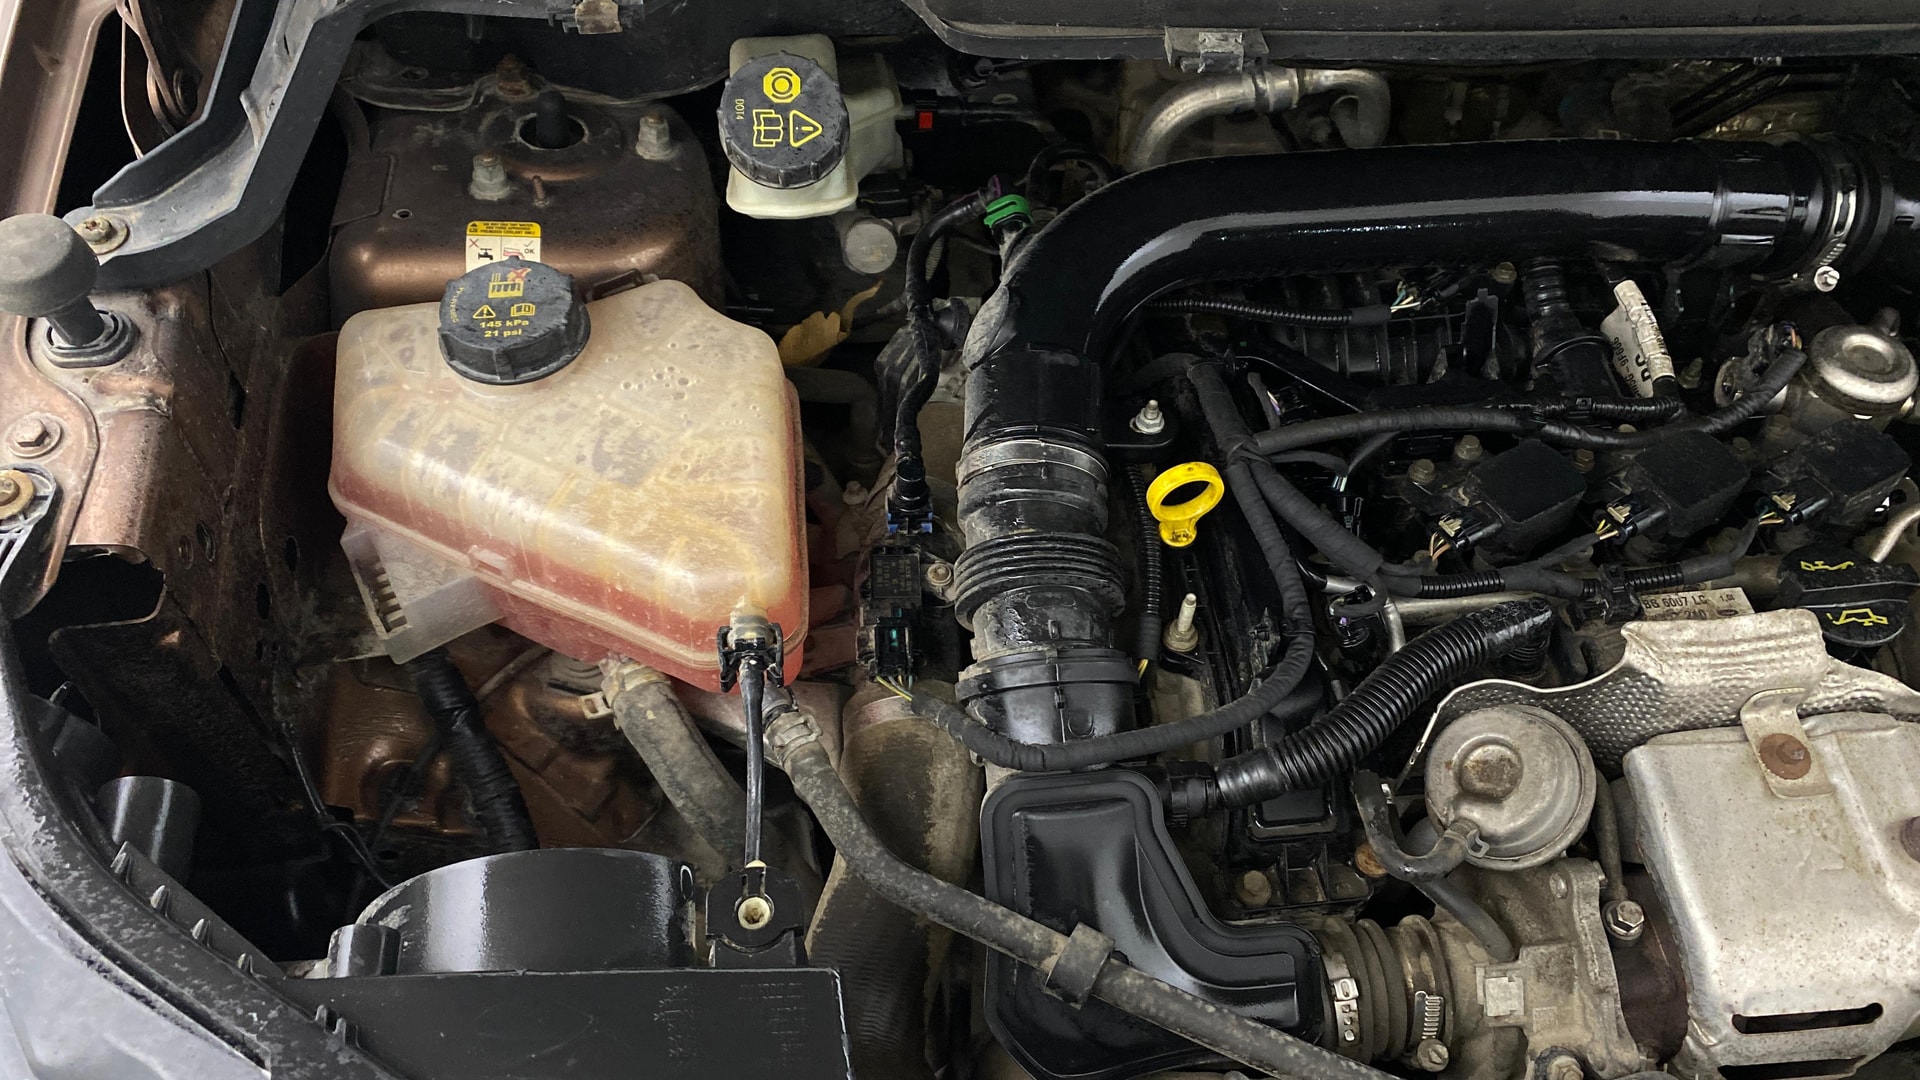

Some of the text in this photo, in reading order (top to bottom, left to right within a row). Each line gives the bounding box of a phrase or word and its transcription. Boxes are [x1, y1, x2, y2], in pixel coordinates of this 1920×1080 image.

[735, 98, 745, 120] DOT4
[479, 319, 530, 329] 145 kPa
[484, 328, 522, 338] 21 psi
